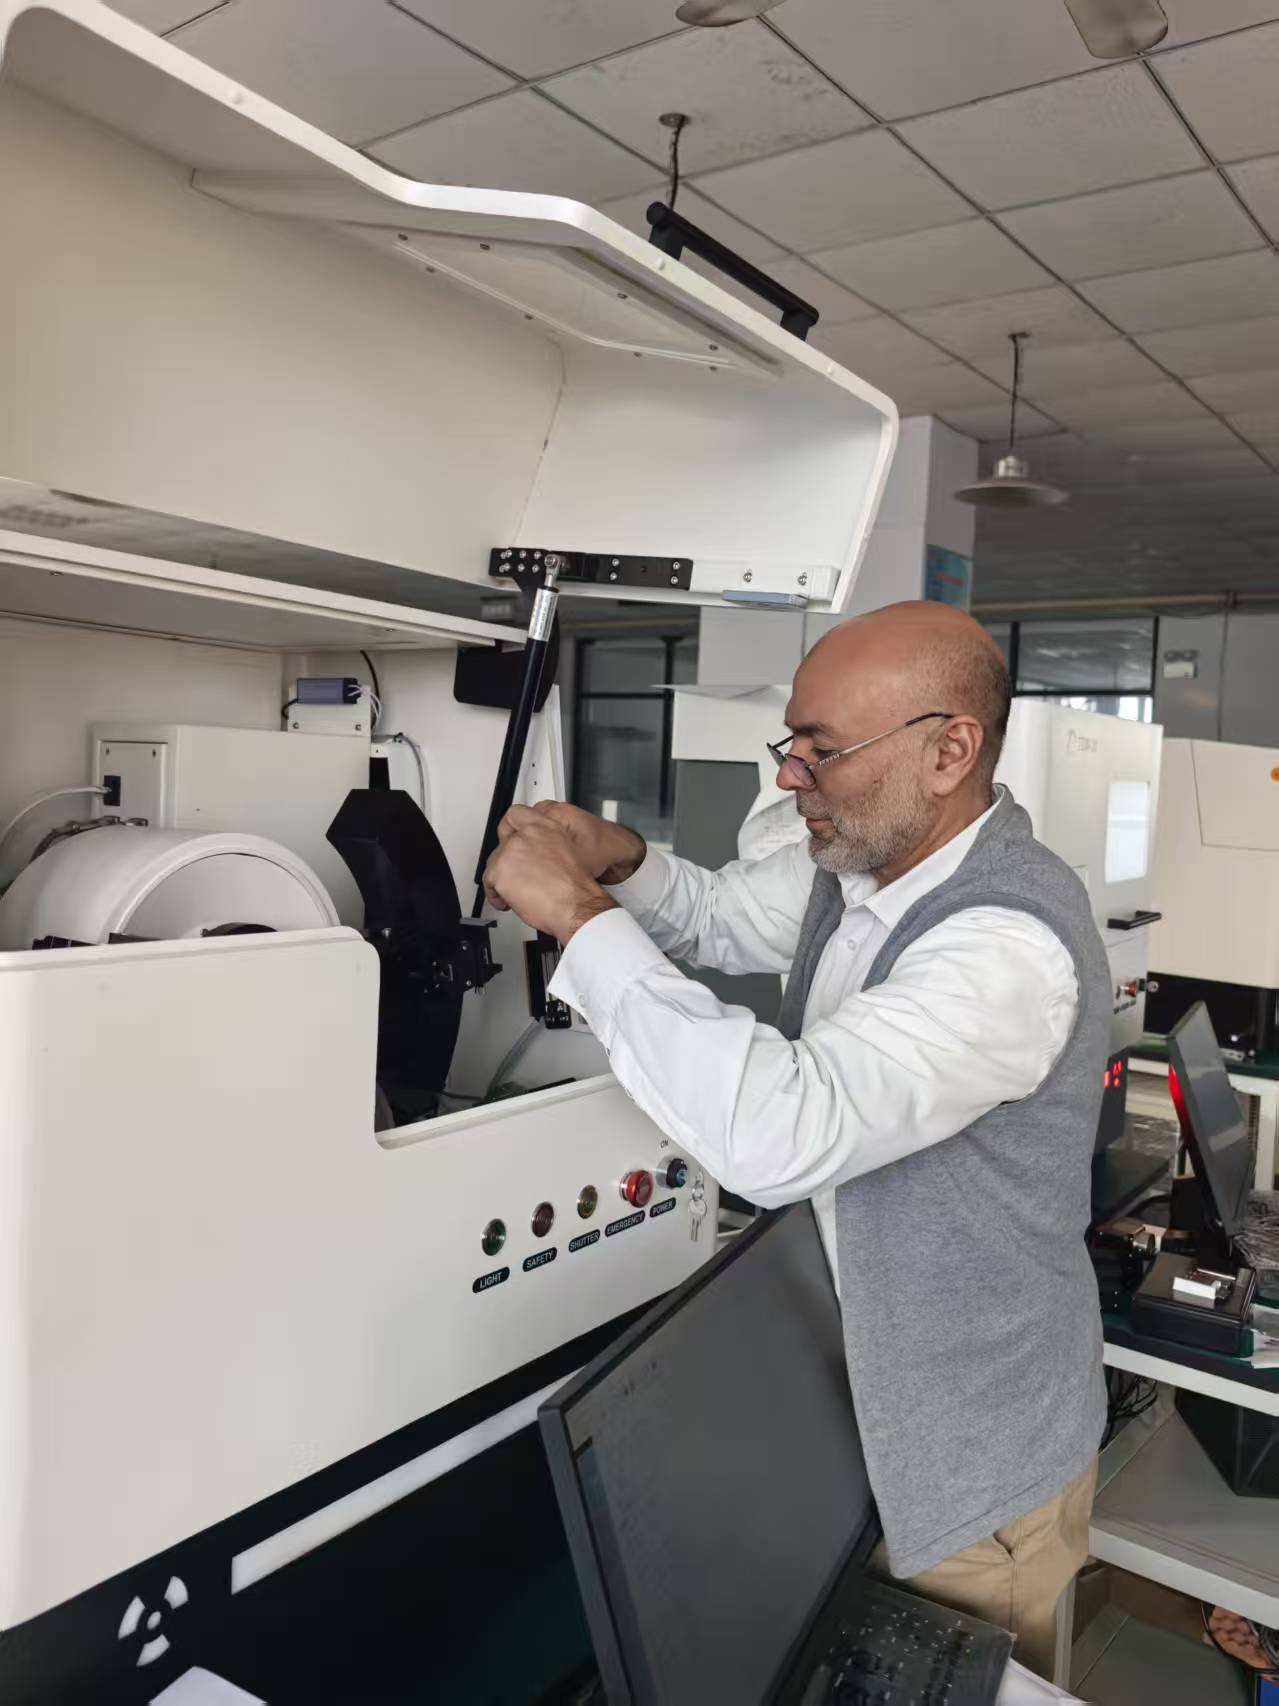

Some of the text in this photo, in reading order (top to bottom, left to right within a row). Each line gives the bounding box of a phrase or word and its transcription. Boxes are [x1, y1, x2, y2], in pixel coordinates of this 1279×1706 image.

[652, 1200, 674, 1214] POWER
[607, 1212, 644, 1235] EMERGENCY
[570, 1231, 600, 1251] SHUTTER
[526, 1250, 554, 1269] SAFETY
[479, 1272, 503, 1289] LIGHT
